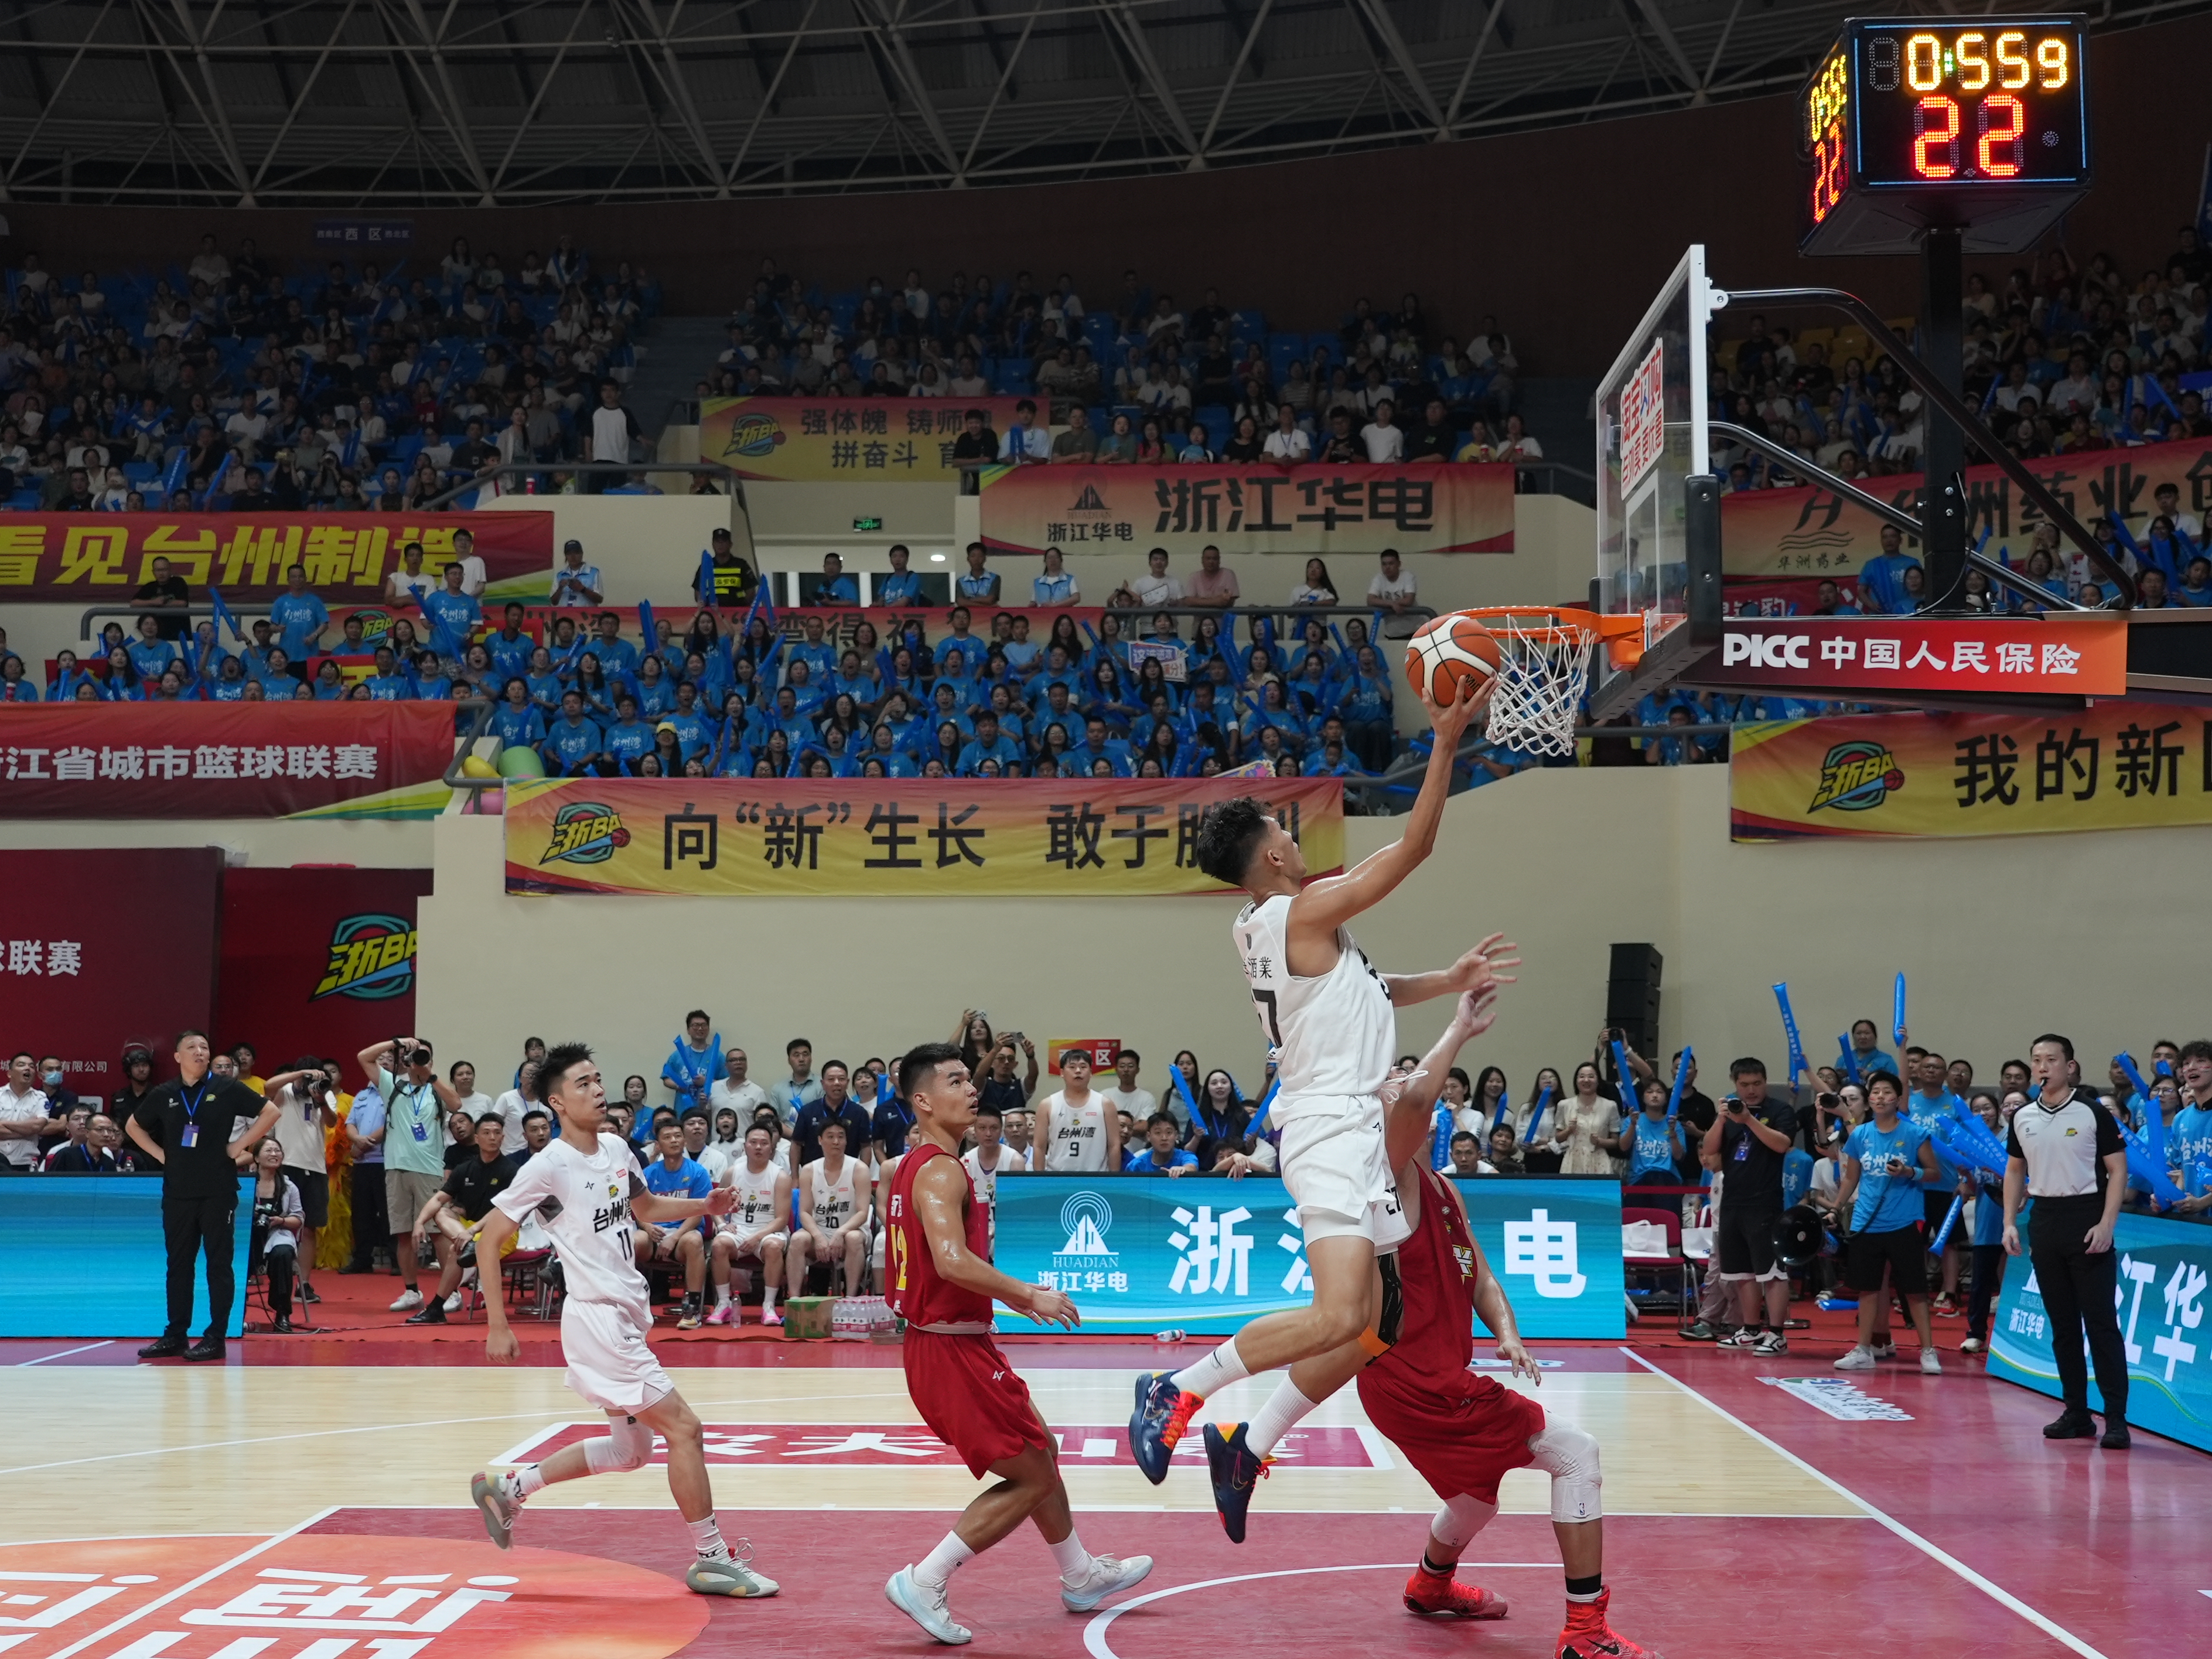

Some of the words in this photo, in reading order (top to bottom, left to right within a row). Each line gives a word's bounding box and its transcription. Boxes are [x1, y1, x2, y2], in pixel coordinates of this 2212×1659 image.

[1914, 94, 2023, 177] 22
[1622, 346, 1661, 452] 淘宝闪购
[801, 408, 887, 436] 强体魄
[907, 408, 992, 436] 铸师
[832, 441, 918, 469] 拼奋斗
[1153, 476, 1434, 533] 浙江华电
[1047, 522, 1134, 542] 浙江华电
[1723, 633, 1810, 668] PICC
[1820, 636, 2082, 675] 中国人民保险
[0, 743, 378, 781] 江省城市篮球联赛
[663, 801, 986, 871] 向“新”生长
[0, 939, 82, 977] 联赛
[1058, 1127, 1097, 1139] 台州湾
[1069, 1142, 1080, 1157] 9
[745, 1210, 754, 1223] 6
[815, 1201, 851, 1215] 台州湾
[825, 1216, 839, 1229] 10
[616, 1228, 633, 1261] 11
[1053, 1257, 1119, 1268] HUADIAN
[1037, 1271, 1128, 1292] 浙江华电
[2008, 1307, 2045, 1340] 浙江华电
